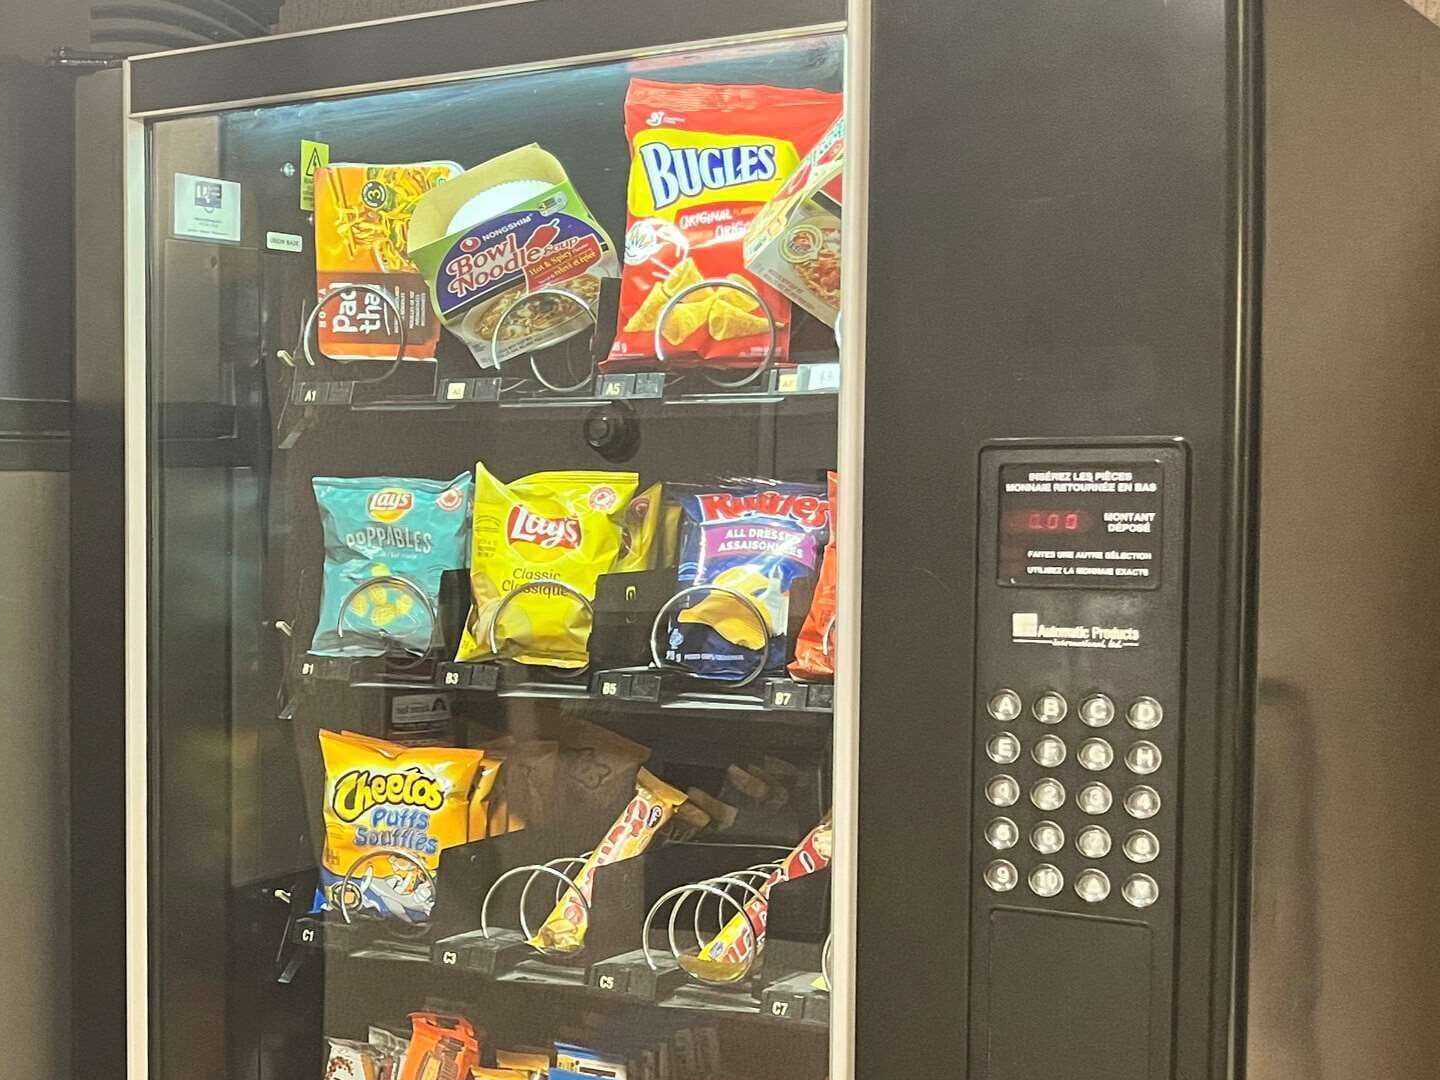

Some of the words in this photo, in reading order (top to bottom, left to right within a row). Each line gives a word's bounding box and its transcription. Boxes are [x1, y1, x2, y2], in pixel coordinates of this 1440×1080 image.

[640, 141, 777, 210] BUGLES
[680, 208, 734, 230] ORIGINAL
[482, 214, 533, 242] NONGSHIM
[446, 231, 517, 278] Bowl
[447, 245, 546, 298] Noodle
[304, 390, 317, 402] A1
[605, 382, 621, 396] A5
[1117, 483, 1133, 492] EN
[1134, 483, 1158, 492] BAS
[370, 491, 411, 512] Lay's
[1103, 512, 1156, 522] MONTANT
[509, 505, 579, 548] Lay's
[345, 525, 433, 555] POPPABLES
[724, 528, 747, 540] ALL
[748, 528, 806, 542] DRESS
[512, 567, 561, 581] Classic
[1063, 567, 1075, 575] LA
[1038, 624, 1090, 639] Automatic
[1091, 626, 1140, 641] Products
[301, 663, 314, 676] B1
[445, 671, 460, 685] B3
[602, 682, 617, 696] B5
[775, 692, 792, 706] B7
[332, 767, 446, 823] Cheetos
[371, 806, 430, 831] Puffs
[302, 929, 314, 942] C1
[442, 951, 457, 965] C3
[599, 975, 615, 990] C5
[771, 1001, 789, 1017] C7
